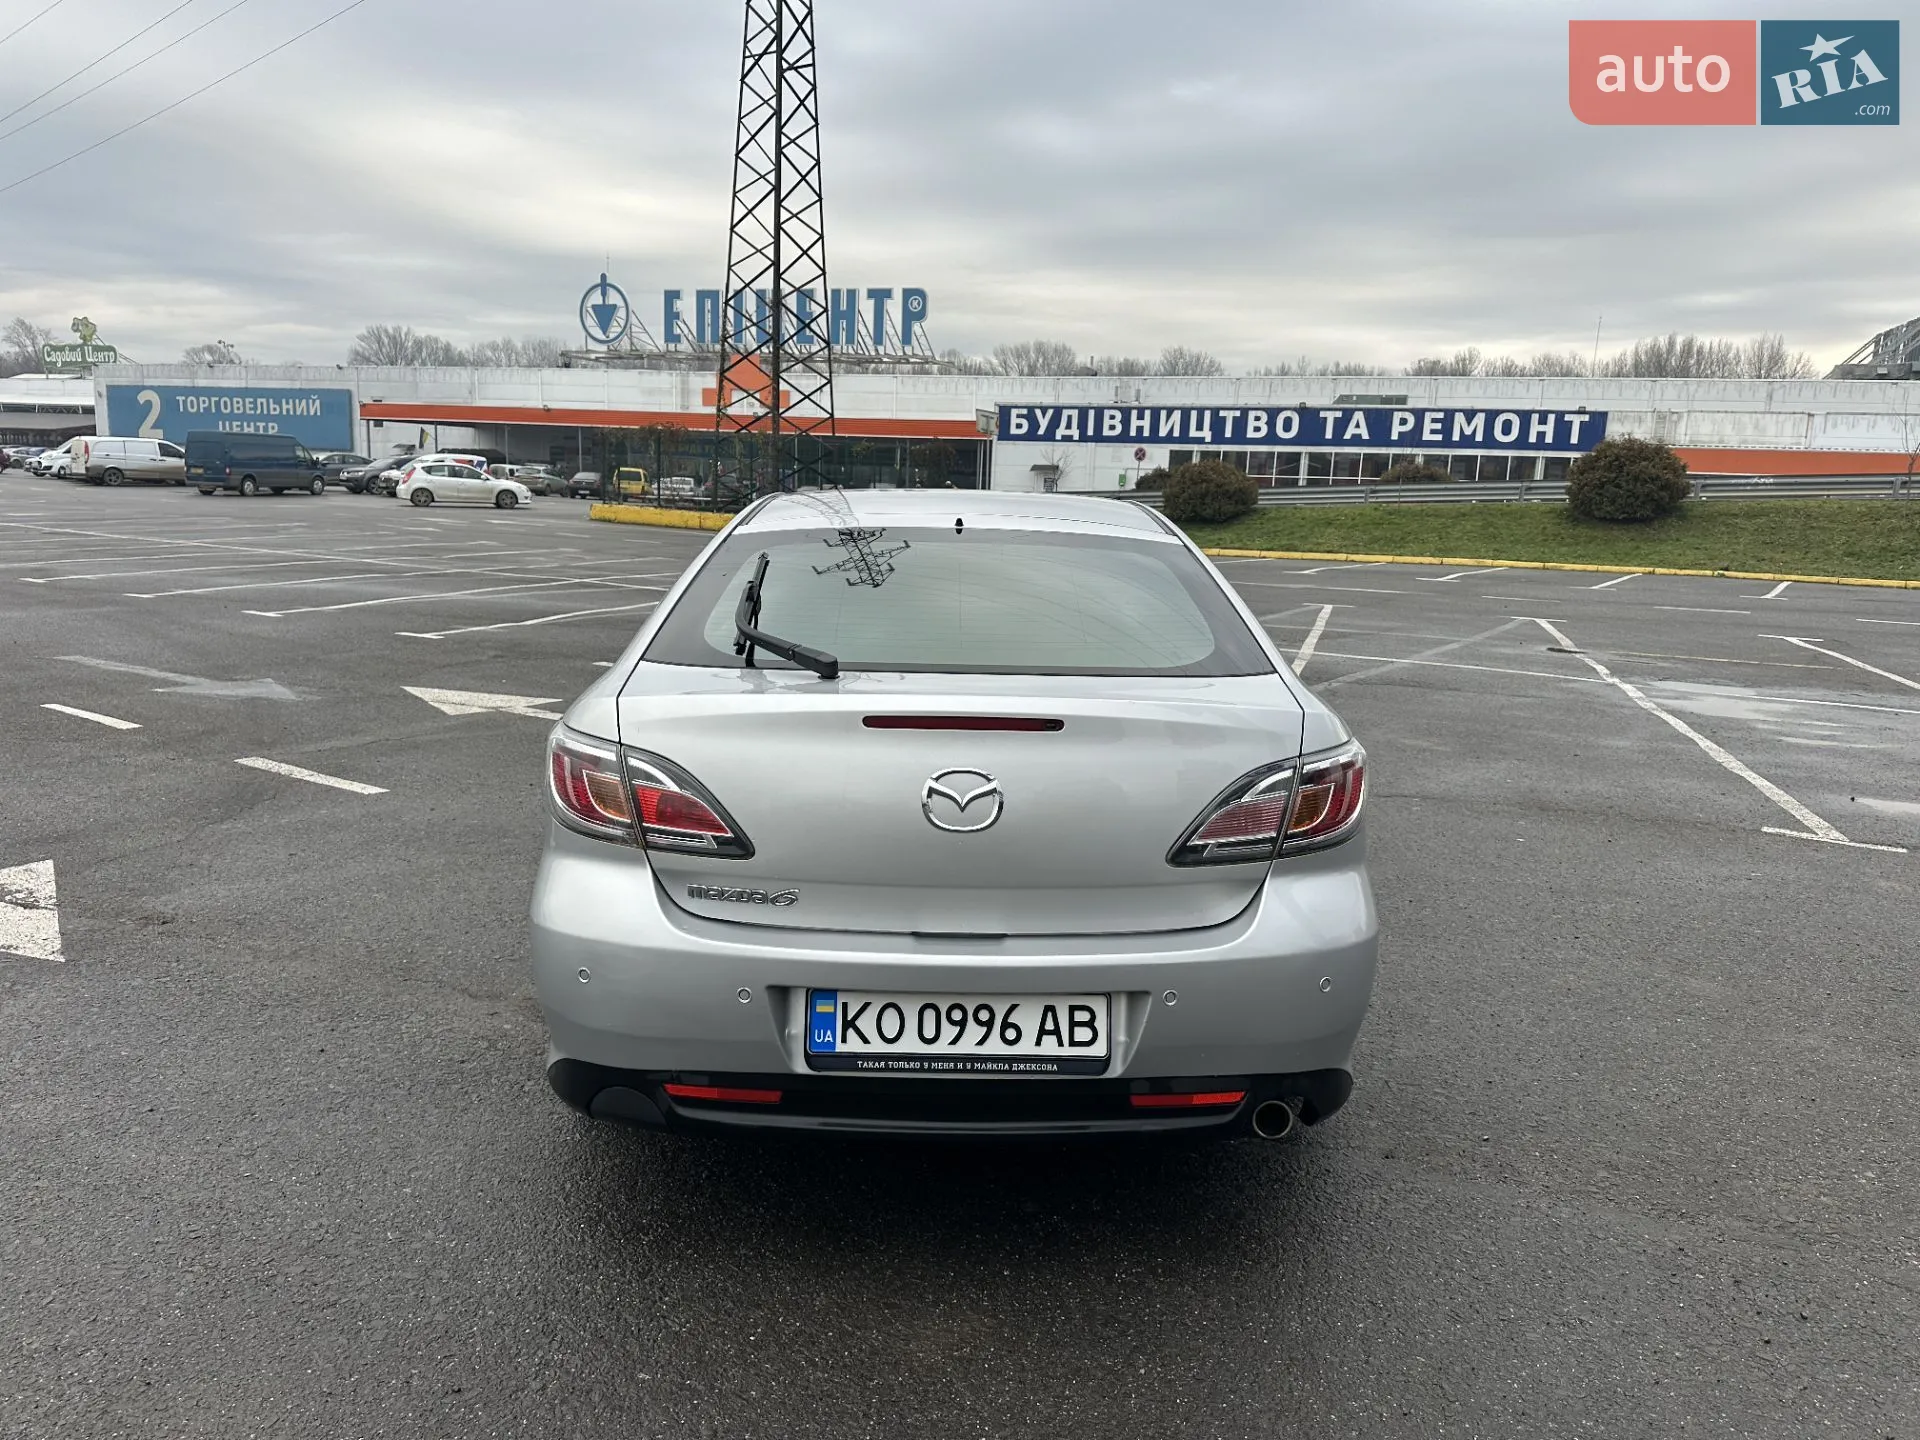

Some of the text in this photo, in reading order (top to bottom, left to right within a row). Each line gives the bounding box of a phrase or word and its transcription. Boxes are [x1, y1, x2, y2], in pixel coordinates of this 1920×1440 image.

[663, 287, 929, 346] ЕПІЦЕНТР
[43, 346, 115, 367] Садовий Центр
[137, 389, 321, 439] 2 ТОРГОВЕЛЬНИЙ
[1009, 408, 1590, 445] БУДІВНИЦТВО ТА РЕМОНТ
[814, 1029, 834, 1043] UA
[840, 1001, 1099, 1048] KO 0996 AB
[857, 1061, 885, 1069] ТАКАЯ
[888, 1061, 920, 1069] ТОЛЬКО
[931, 1062, 954, 1070] МЕНЯ
[974, 1062, 1009, 1071] МАЙКЛА
[1012, 1063, 1058, 1071] ДЖЕКСОНА
